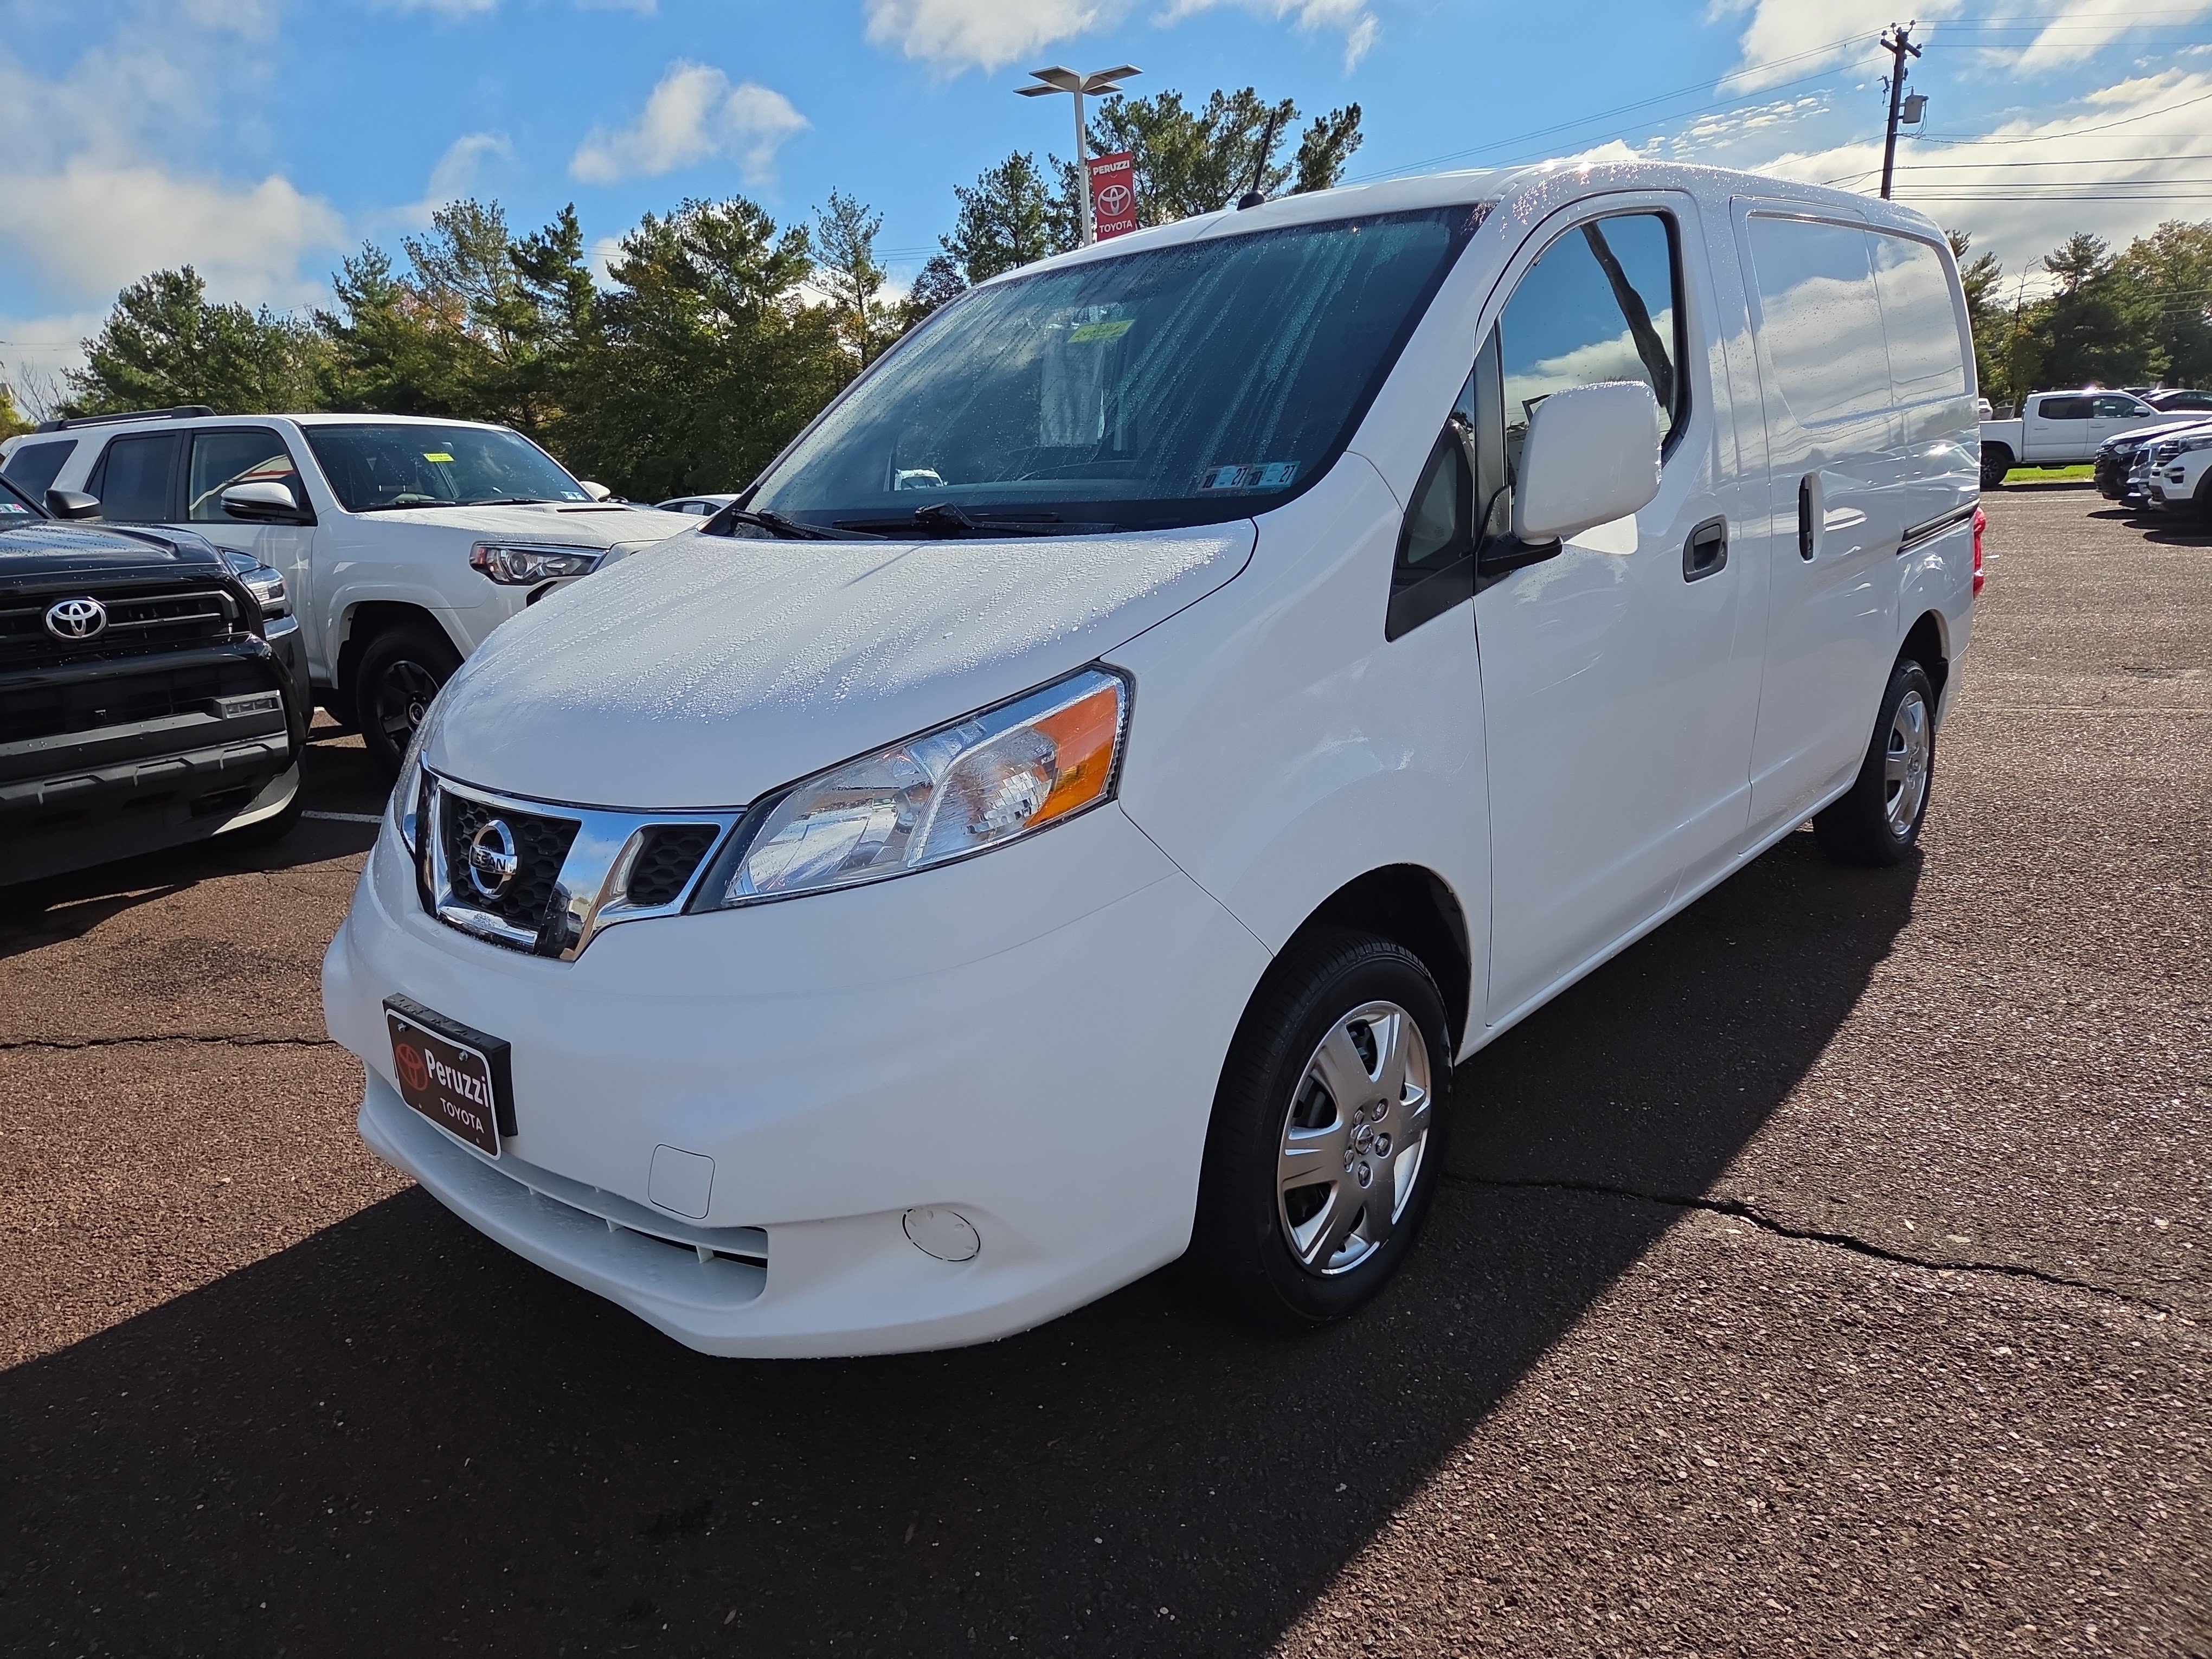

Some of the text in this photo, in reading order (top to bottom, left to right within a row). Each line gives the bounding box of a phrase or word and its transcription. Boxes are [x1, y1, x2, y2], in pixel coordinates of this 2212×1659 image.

[1093, 160, 1130, 176] PERUZZI
[1099, 220, 1133, 233] TOYOTA
[1231, 468, 1248, 486] 27
[1279, 465, 1296, 483] 27
[425, 1049, 488, 1107] Peruzzi
[440, 1097, 485, 1134] TOYOTA
